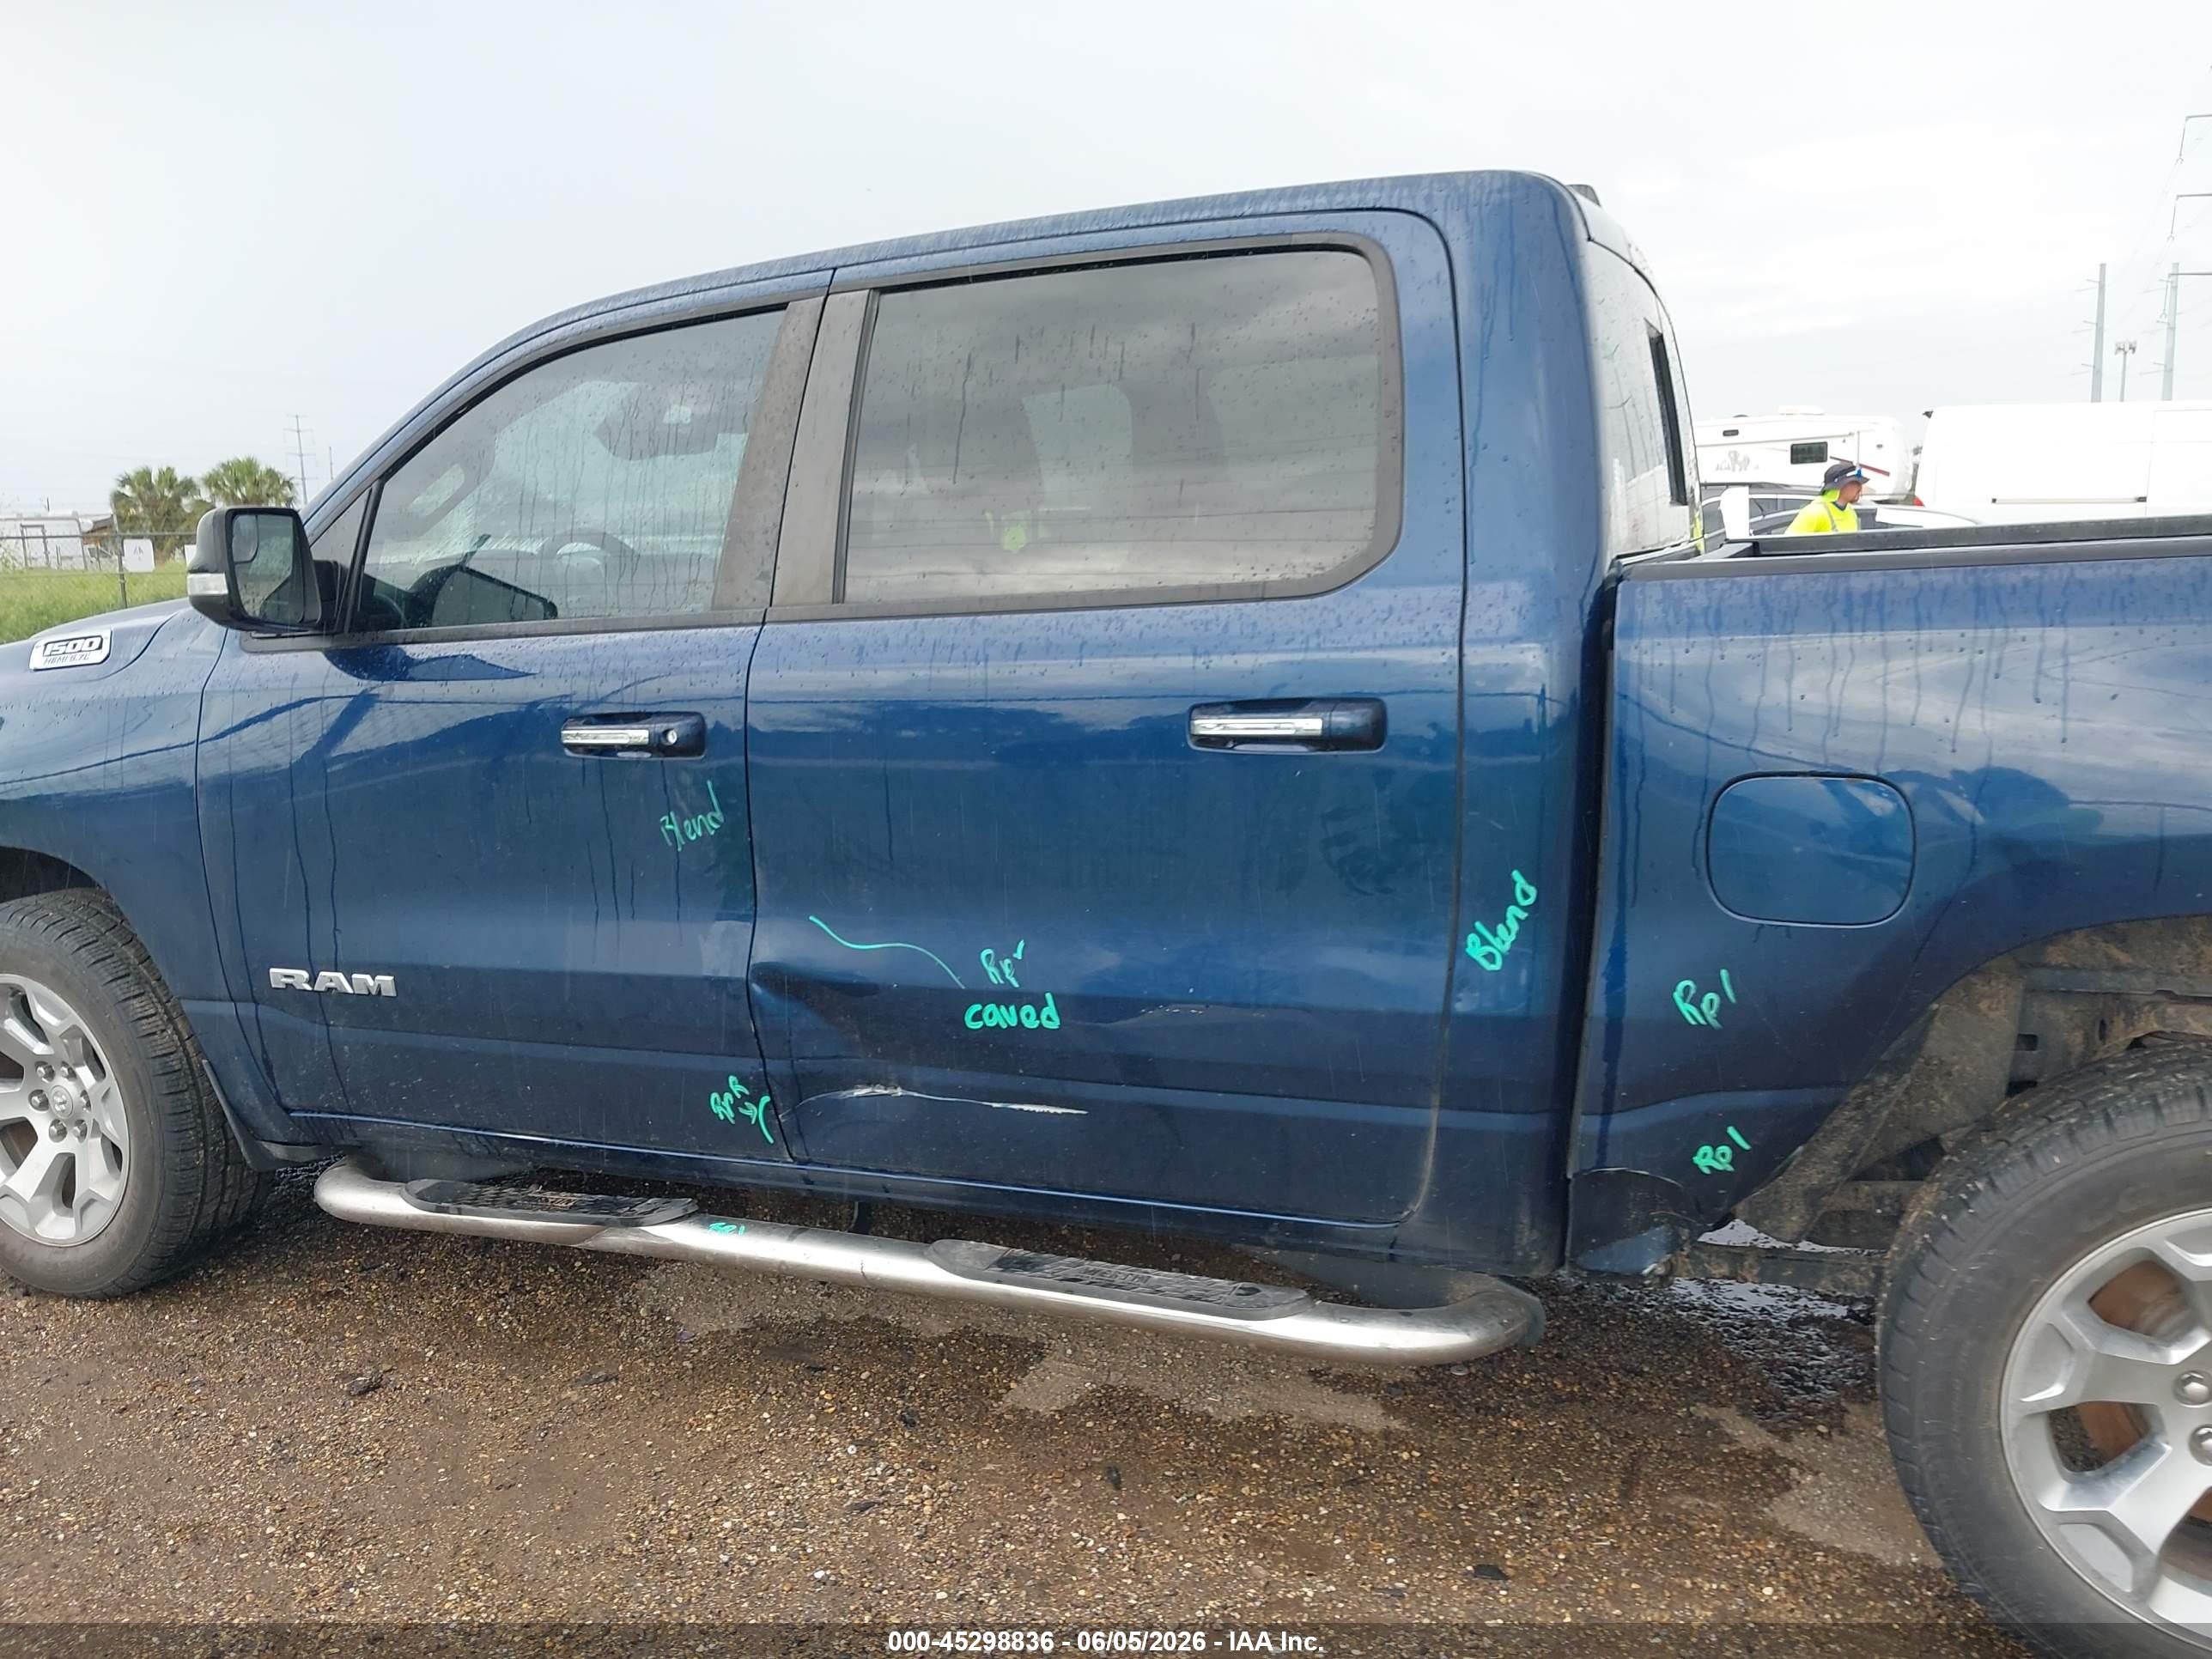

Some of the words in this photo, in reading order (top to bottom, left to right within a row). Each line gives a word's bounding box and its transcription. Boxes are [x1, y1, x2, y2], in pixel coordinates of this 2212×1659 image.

[44, 636, 101, 656] 1500
[269, 968, 397, 997] RAM
[964, 992, 1060, 1030] caved
